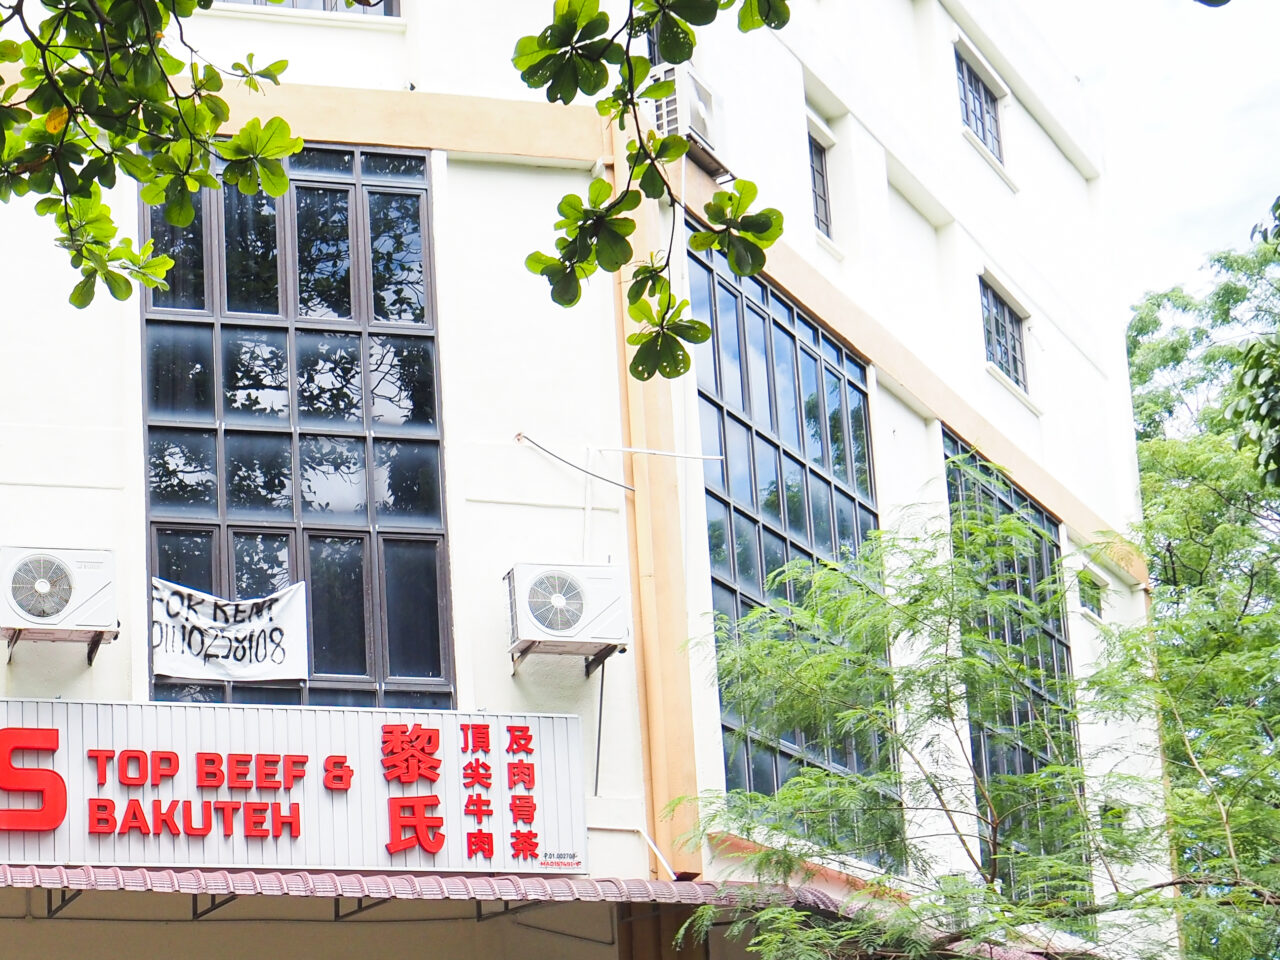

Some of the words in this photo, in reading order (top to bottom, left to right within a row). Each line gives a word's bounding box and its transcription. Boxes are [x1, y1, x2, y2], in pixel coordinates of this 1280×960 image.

[213, 598, 279, 624] RENT
[87, 749, 180, 788] TOP
[196, 752, 309, 790] BEEF
[323, 755, 354, 791] &
[380, 723, 446, 855] 黎氏
[459, 723, 494, 859] 頂尖牛肉
[505, 725, 540, 860] 及肉骨茶
[87, 797, 301, 839] BAKUTEH
